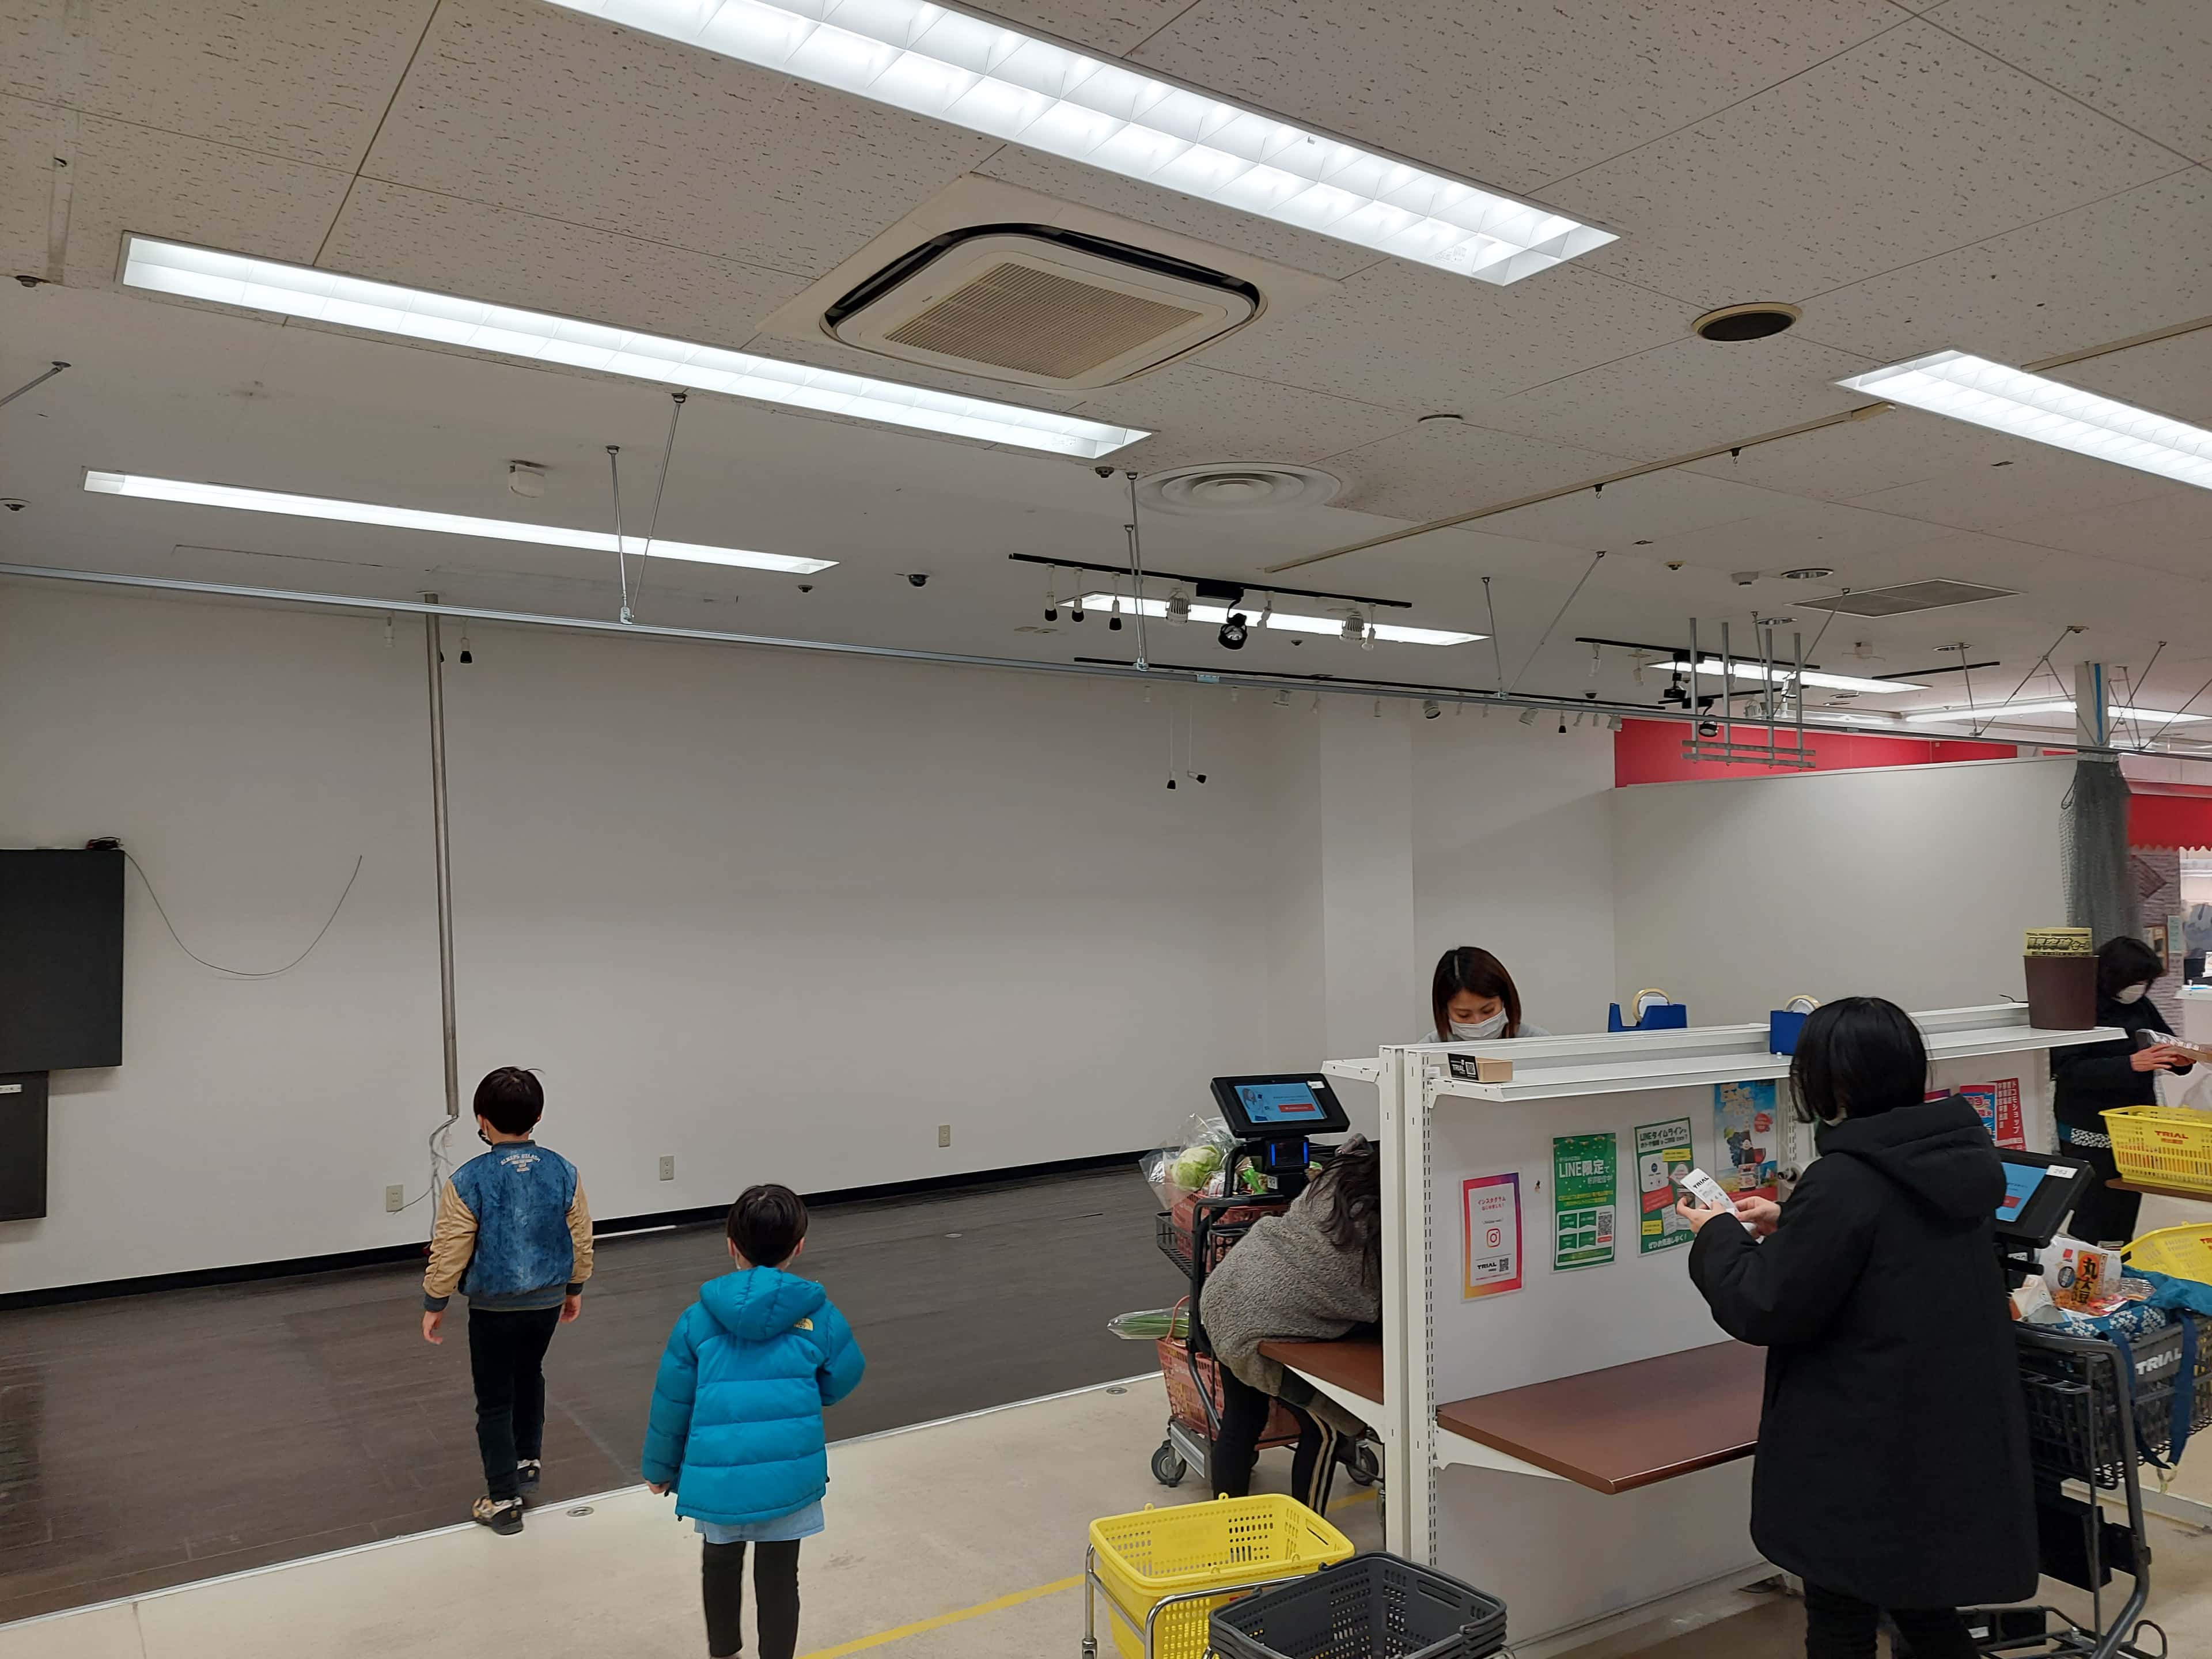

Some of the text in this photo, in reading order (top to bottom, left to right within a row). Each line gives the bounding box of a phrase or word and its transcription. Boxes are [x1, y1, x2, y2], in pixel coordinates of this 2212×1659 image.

[2154, 1130, 2189, 1139] TRIAL
[1692, 1177, 1710, 1189] TRIAL
[1478, 1195, 1506, 1205] インスタグラム
[1477, 1262, 1497, 1270] TRIAL
[2135, 1348, 2182, 1376] TRIAL
